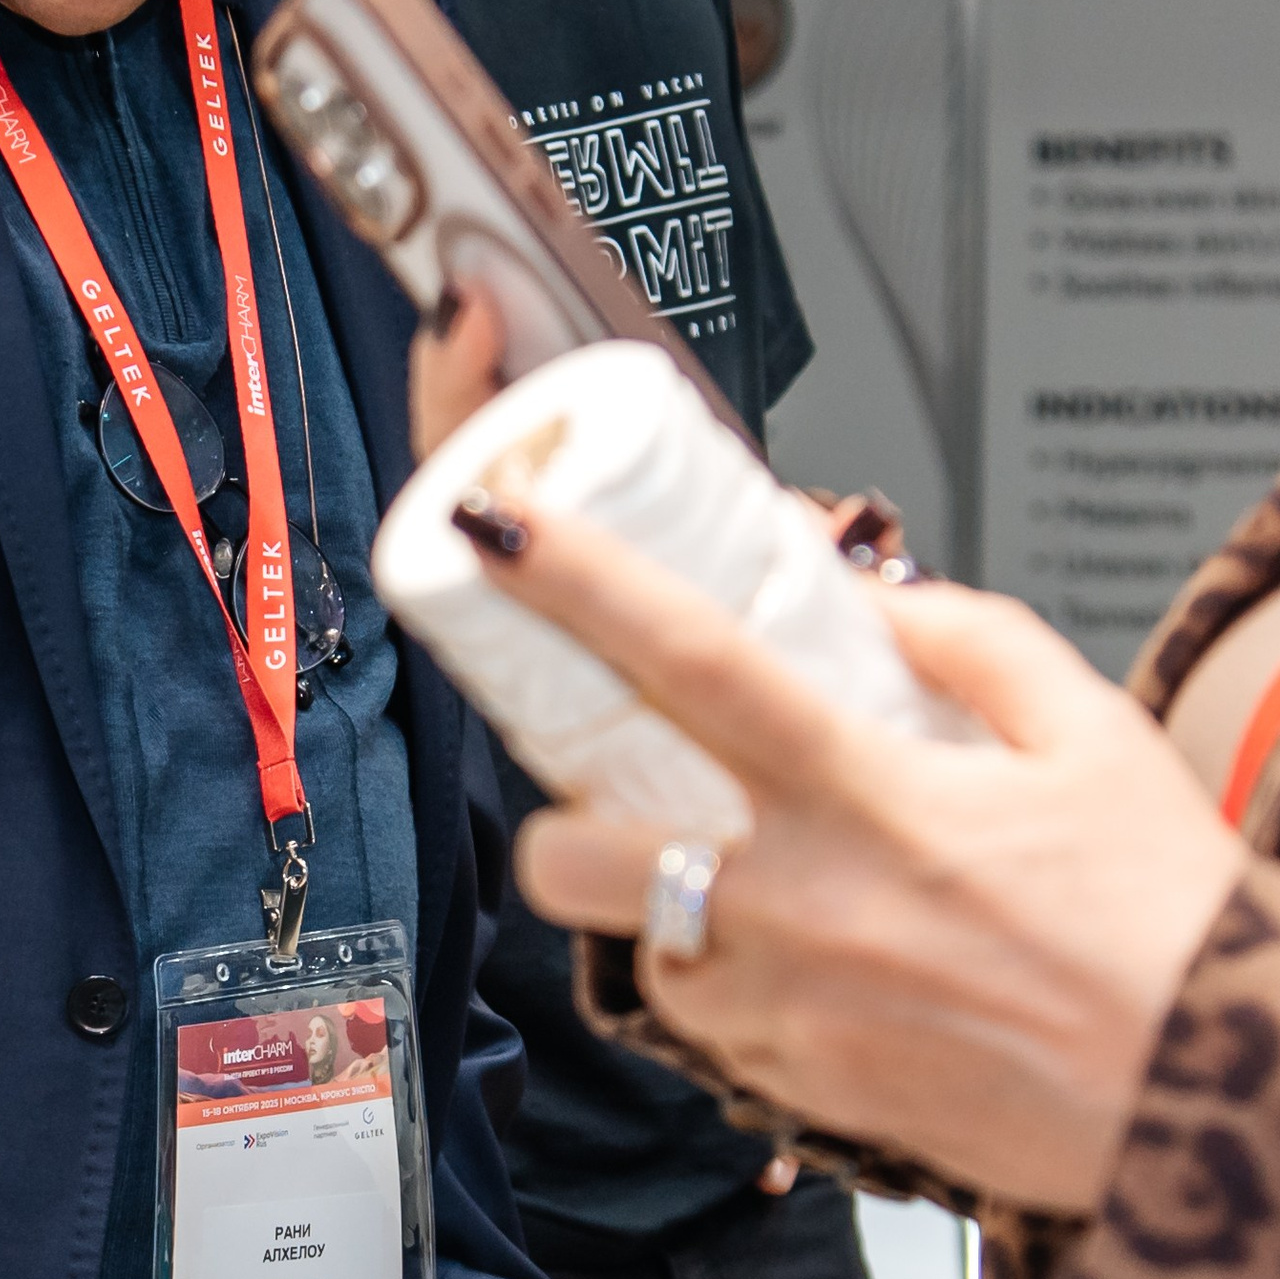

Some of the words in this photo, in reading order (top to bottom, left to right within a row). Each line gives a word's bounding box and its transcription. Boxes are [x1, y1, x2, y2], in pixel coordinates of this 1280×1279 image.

[195, 32, 228, 157] GELTEK
[590, 91, 625, 113] ON
[640, 73, 705, 101] VACAY
[81, 278, 151, 408] GELTEK
[234, 274, 266, 417] interCHARM
[262, 541, 287, 670] GELTEK
[223, 1040, 293, 1065] interCHARM
[223, 1102, 259, 1114] ОКТЯБРЯ
[355, 1128, 385, 1140] GELTEK
[275, 1223, 312, 1241] РАНИ
[263, 1243, 326, 1263] АЛХЕЛОУ
